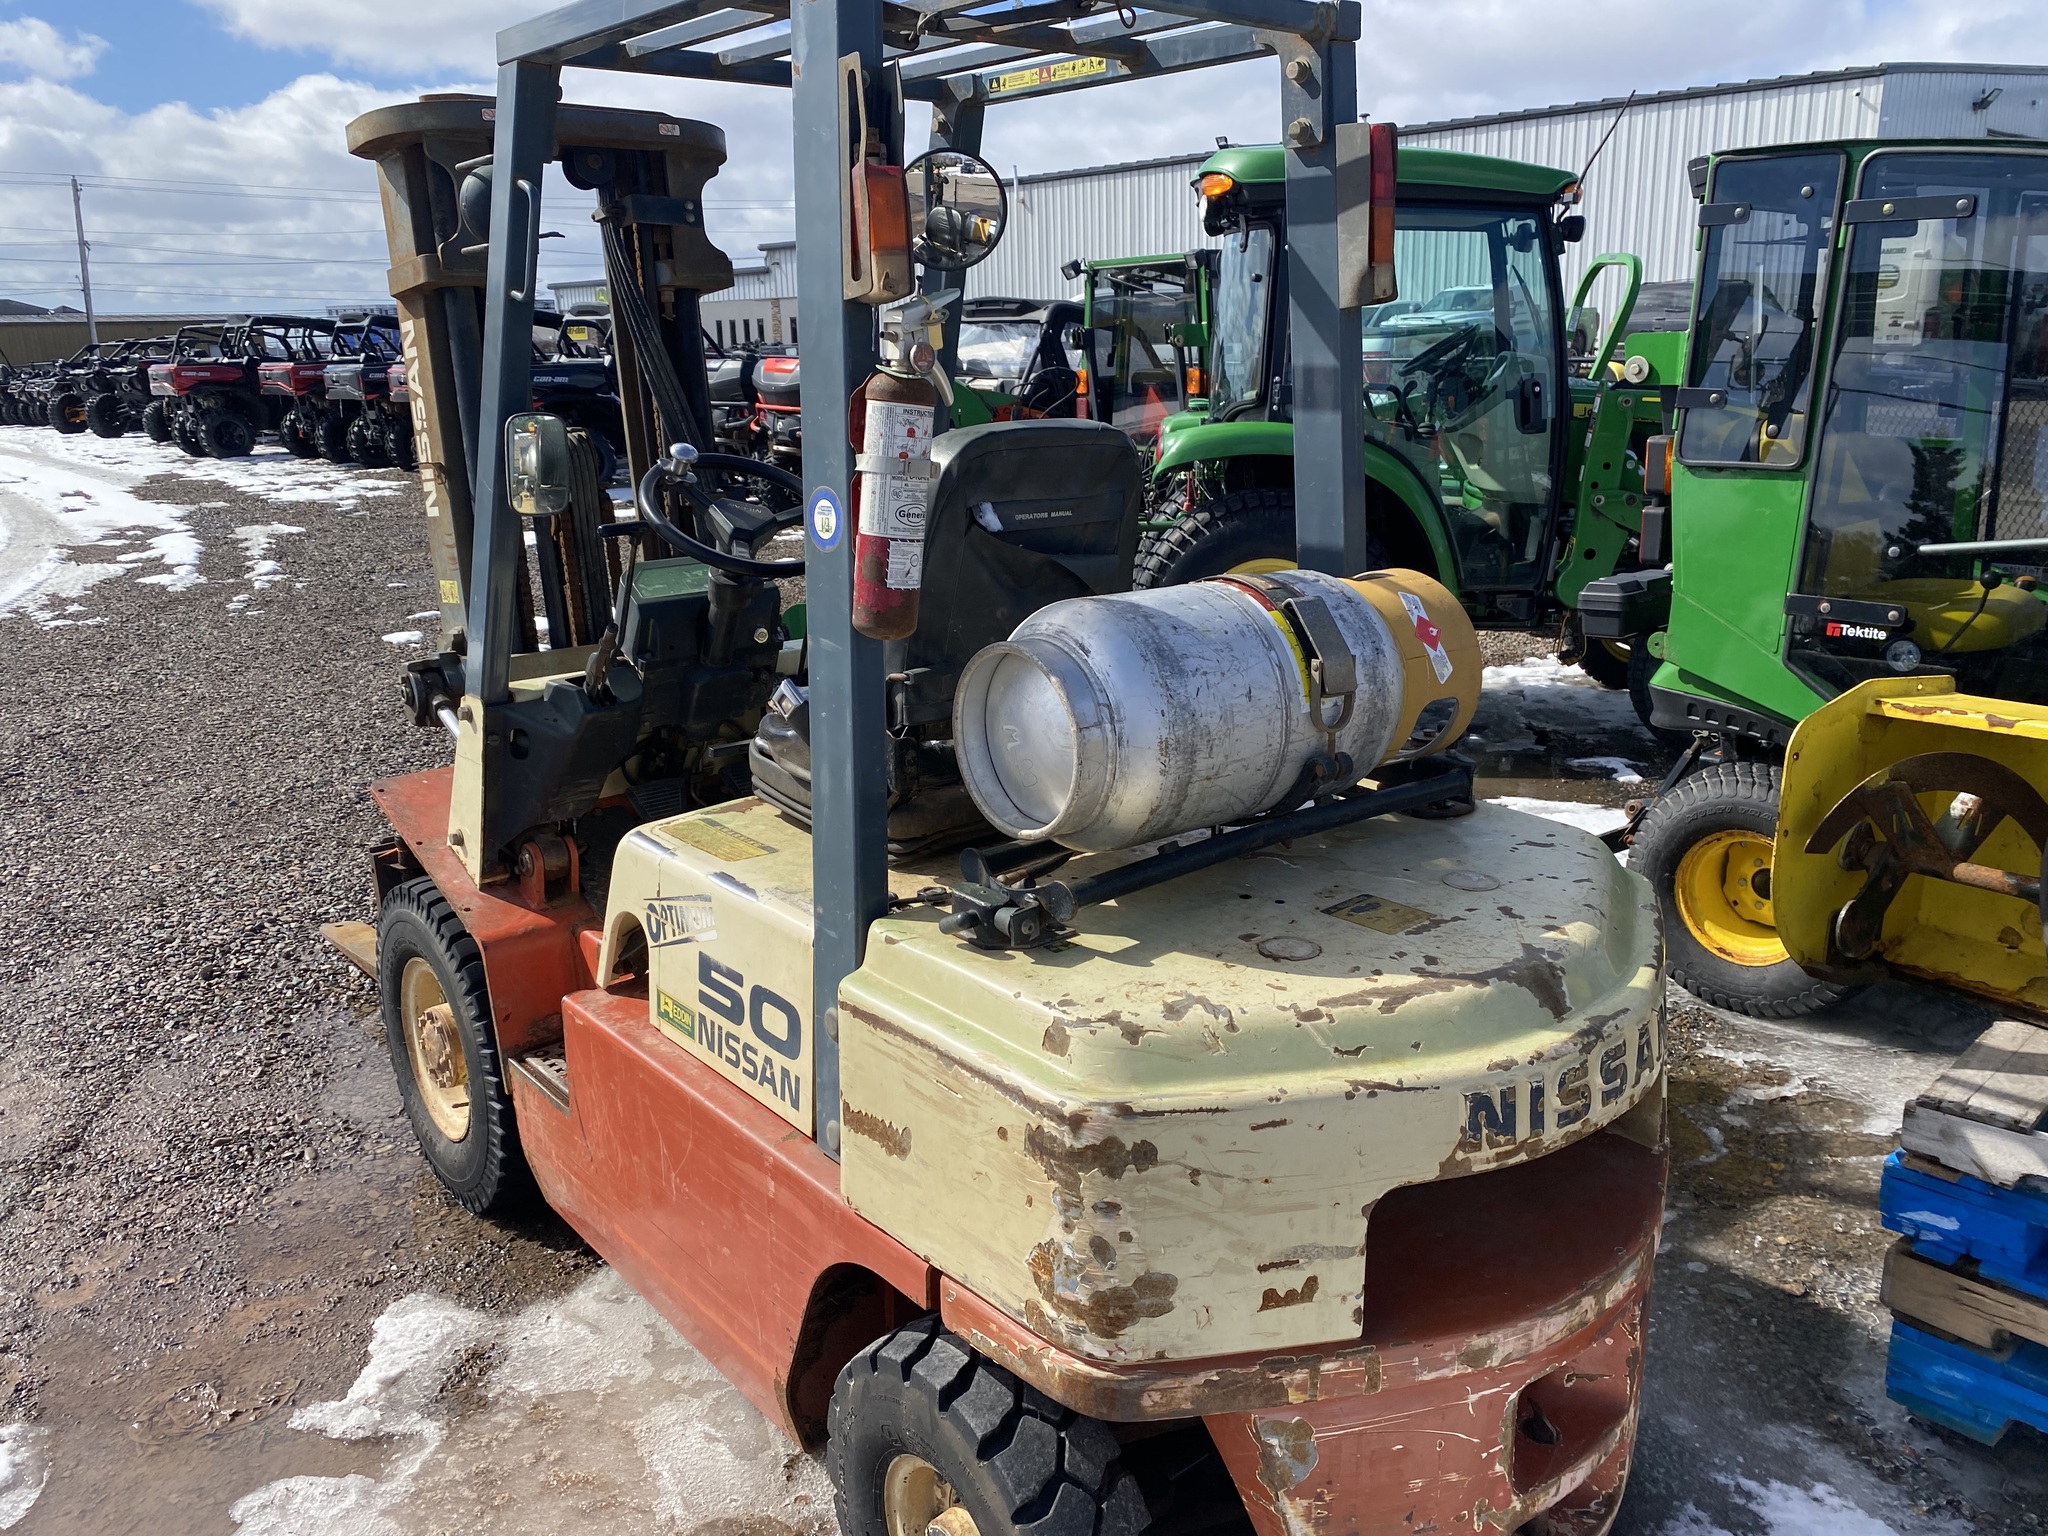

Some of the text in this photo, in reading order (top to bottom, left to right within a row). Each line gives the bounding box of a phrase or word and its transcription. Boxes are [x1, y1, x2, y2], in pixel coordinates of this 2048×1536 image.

[533, 375, 569, 383] can-am
[400, 319, 440, 517] NISSAN
[1014, 510, 1073, 521] OPERATORS MANUAL
[1840, 624, 1887, 640] Tektite
[1685, 805, 1734, 824] MULTI
[698, 950, 801, 1061] 50
[697, 1011, 801, 1113] NISSAN
